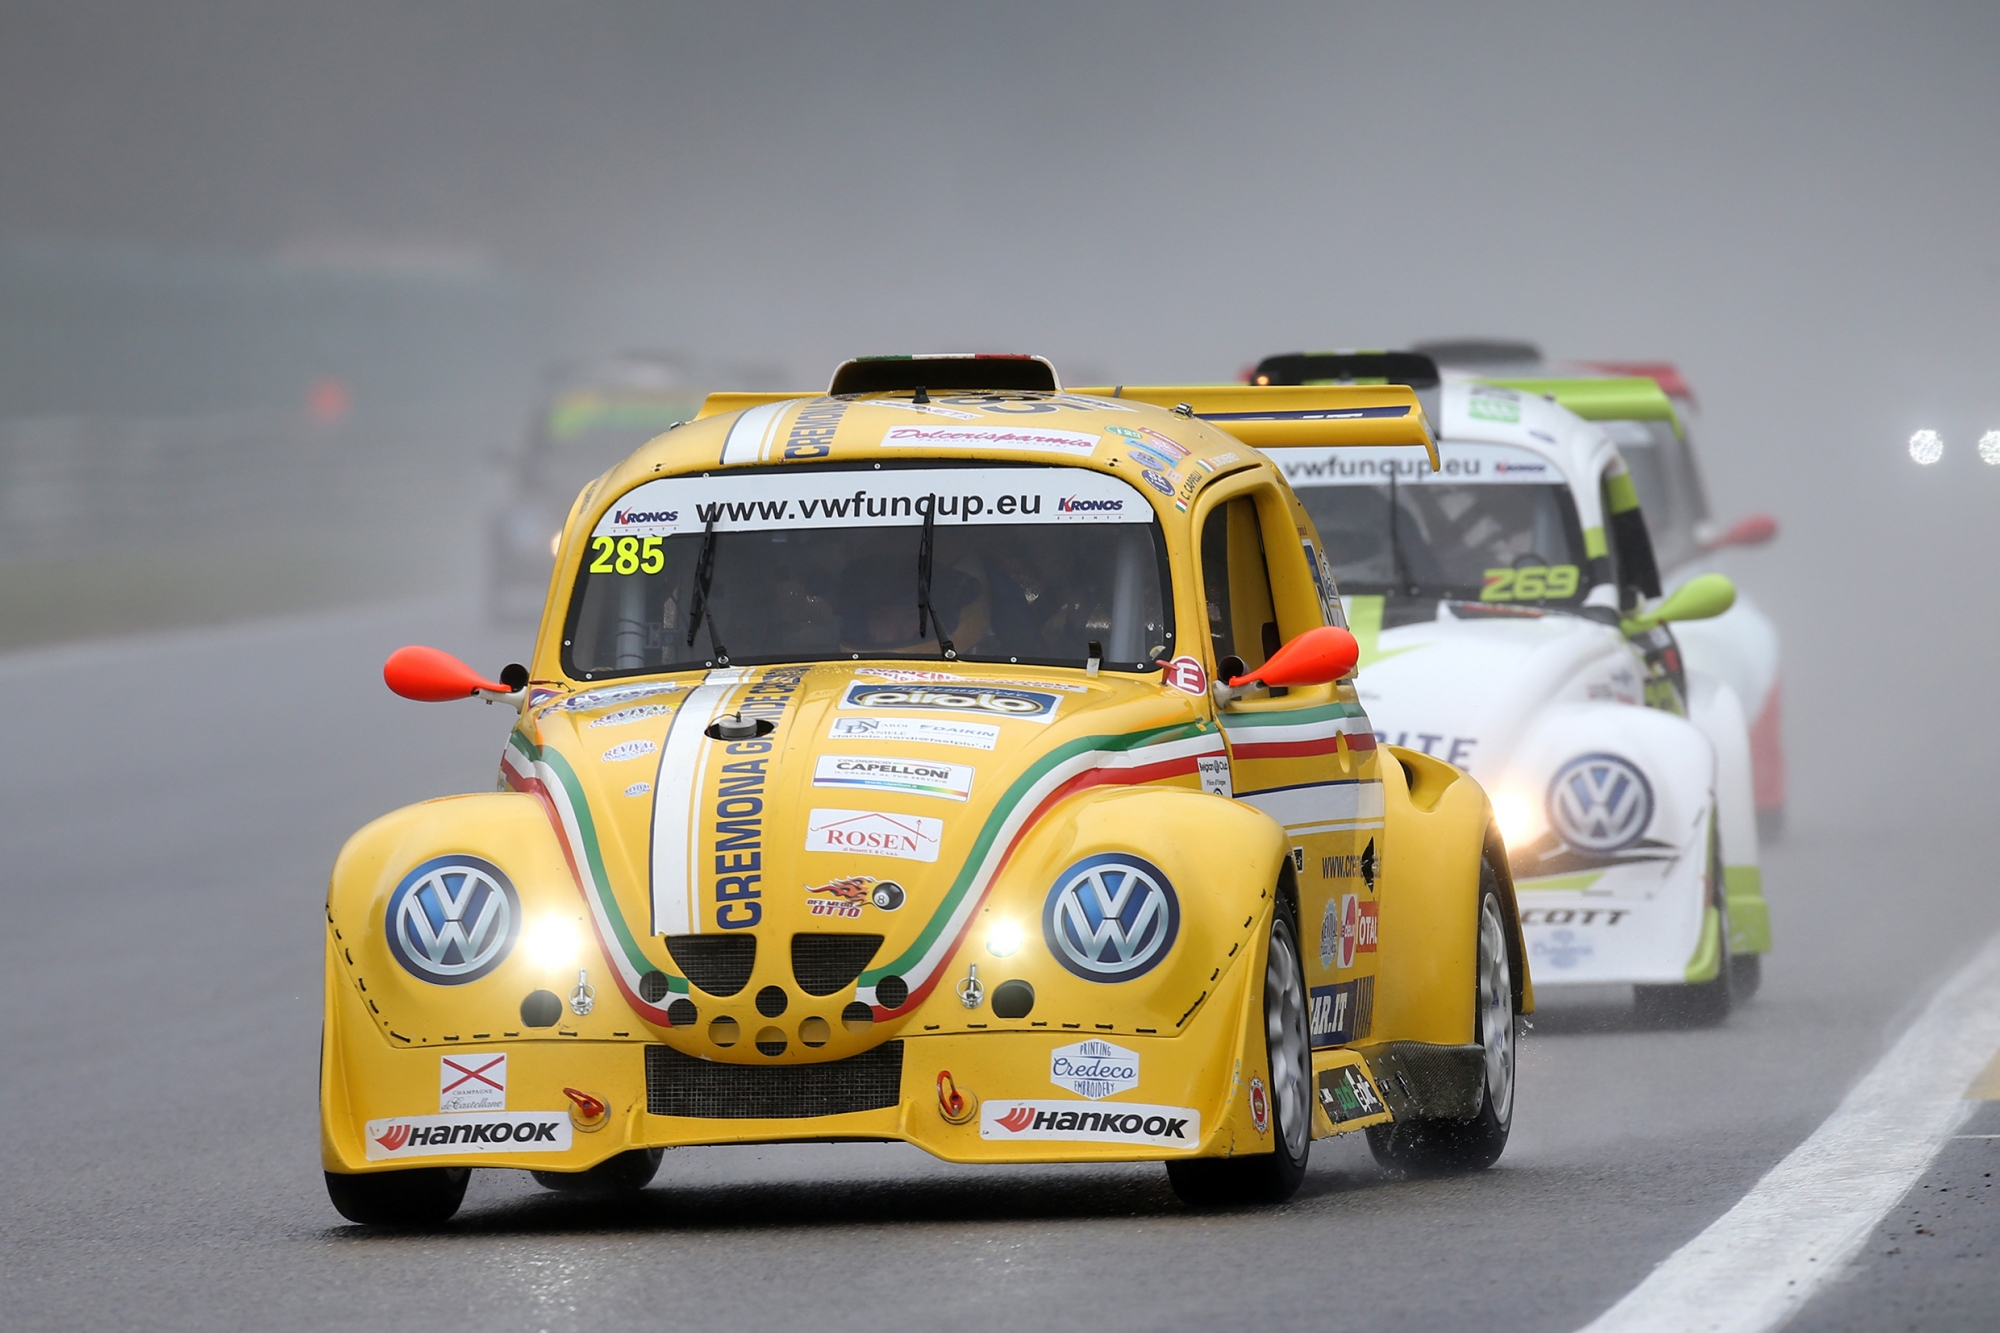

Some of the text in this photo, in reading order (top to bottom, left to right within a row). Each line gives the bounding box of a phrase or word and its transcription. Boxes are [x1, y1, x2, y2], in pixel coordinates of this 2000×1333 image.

[695, 489, 1042, 523] www.vwfuncup.eu
[1057, 493, 1124, 512] KRONOS
[614, 506, 679, 525] KRONOS
[589, 535, 665, 575] 285
[1480, 564, 1580, 601] 269
[1177, 662, 1200, 692] E
[726, 695, 791, 755] GNDE
[932, 725, 996, 738] DAIKIN
[836, 762, 950, 779] CAPELLONI
[715, 757, 769, 930] CREMONA
[827, 829, 919, 852] ROSEN
[812, 905, 861, 918] OTTO
[1356, 908, 1378, 946] TOTAL
[1079, 1041, 1112, 1057] PRINTING
[1053, 1057, 1137, 1079] Credeco
[452, 1088, 493, 1096] CHAMPAGNE
[1074, 1080, 1115, 1098] EMBROIDERY
[407, 1121, 560, 1148] HANKOOK
[1032, 1110, 1190, 1139] HANKOOK
